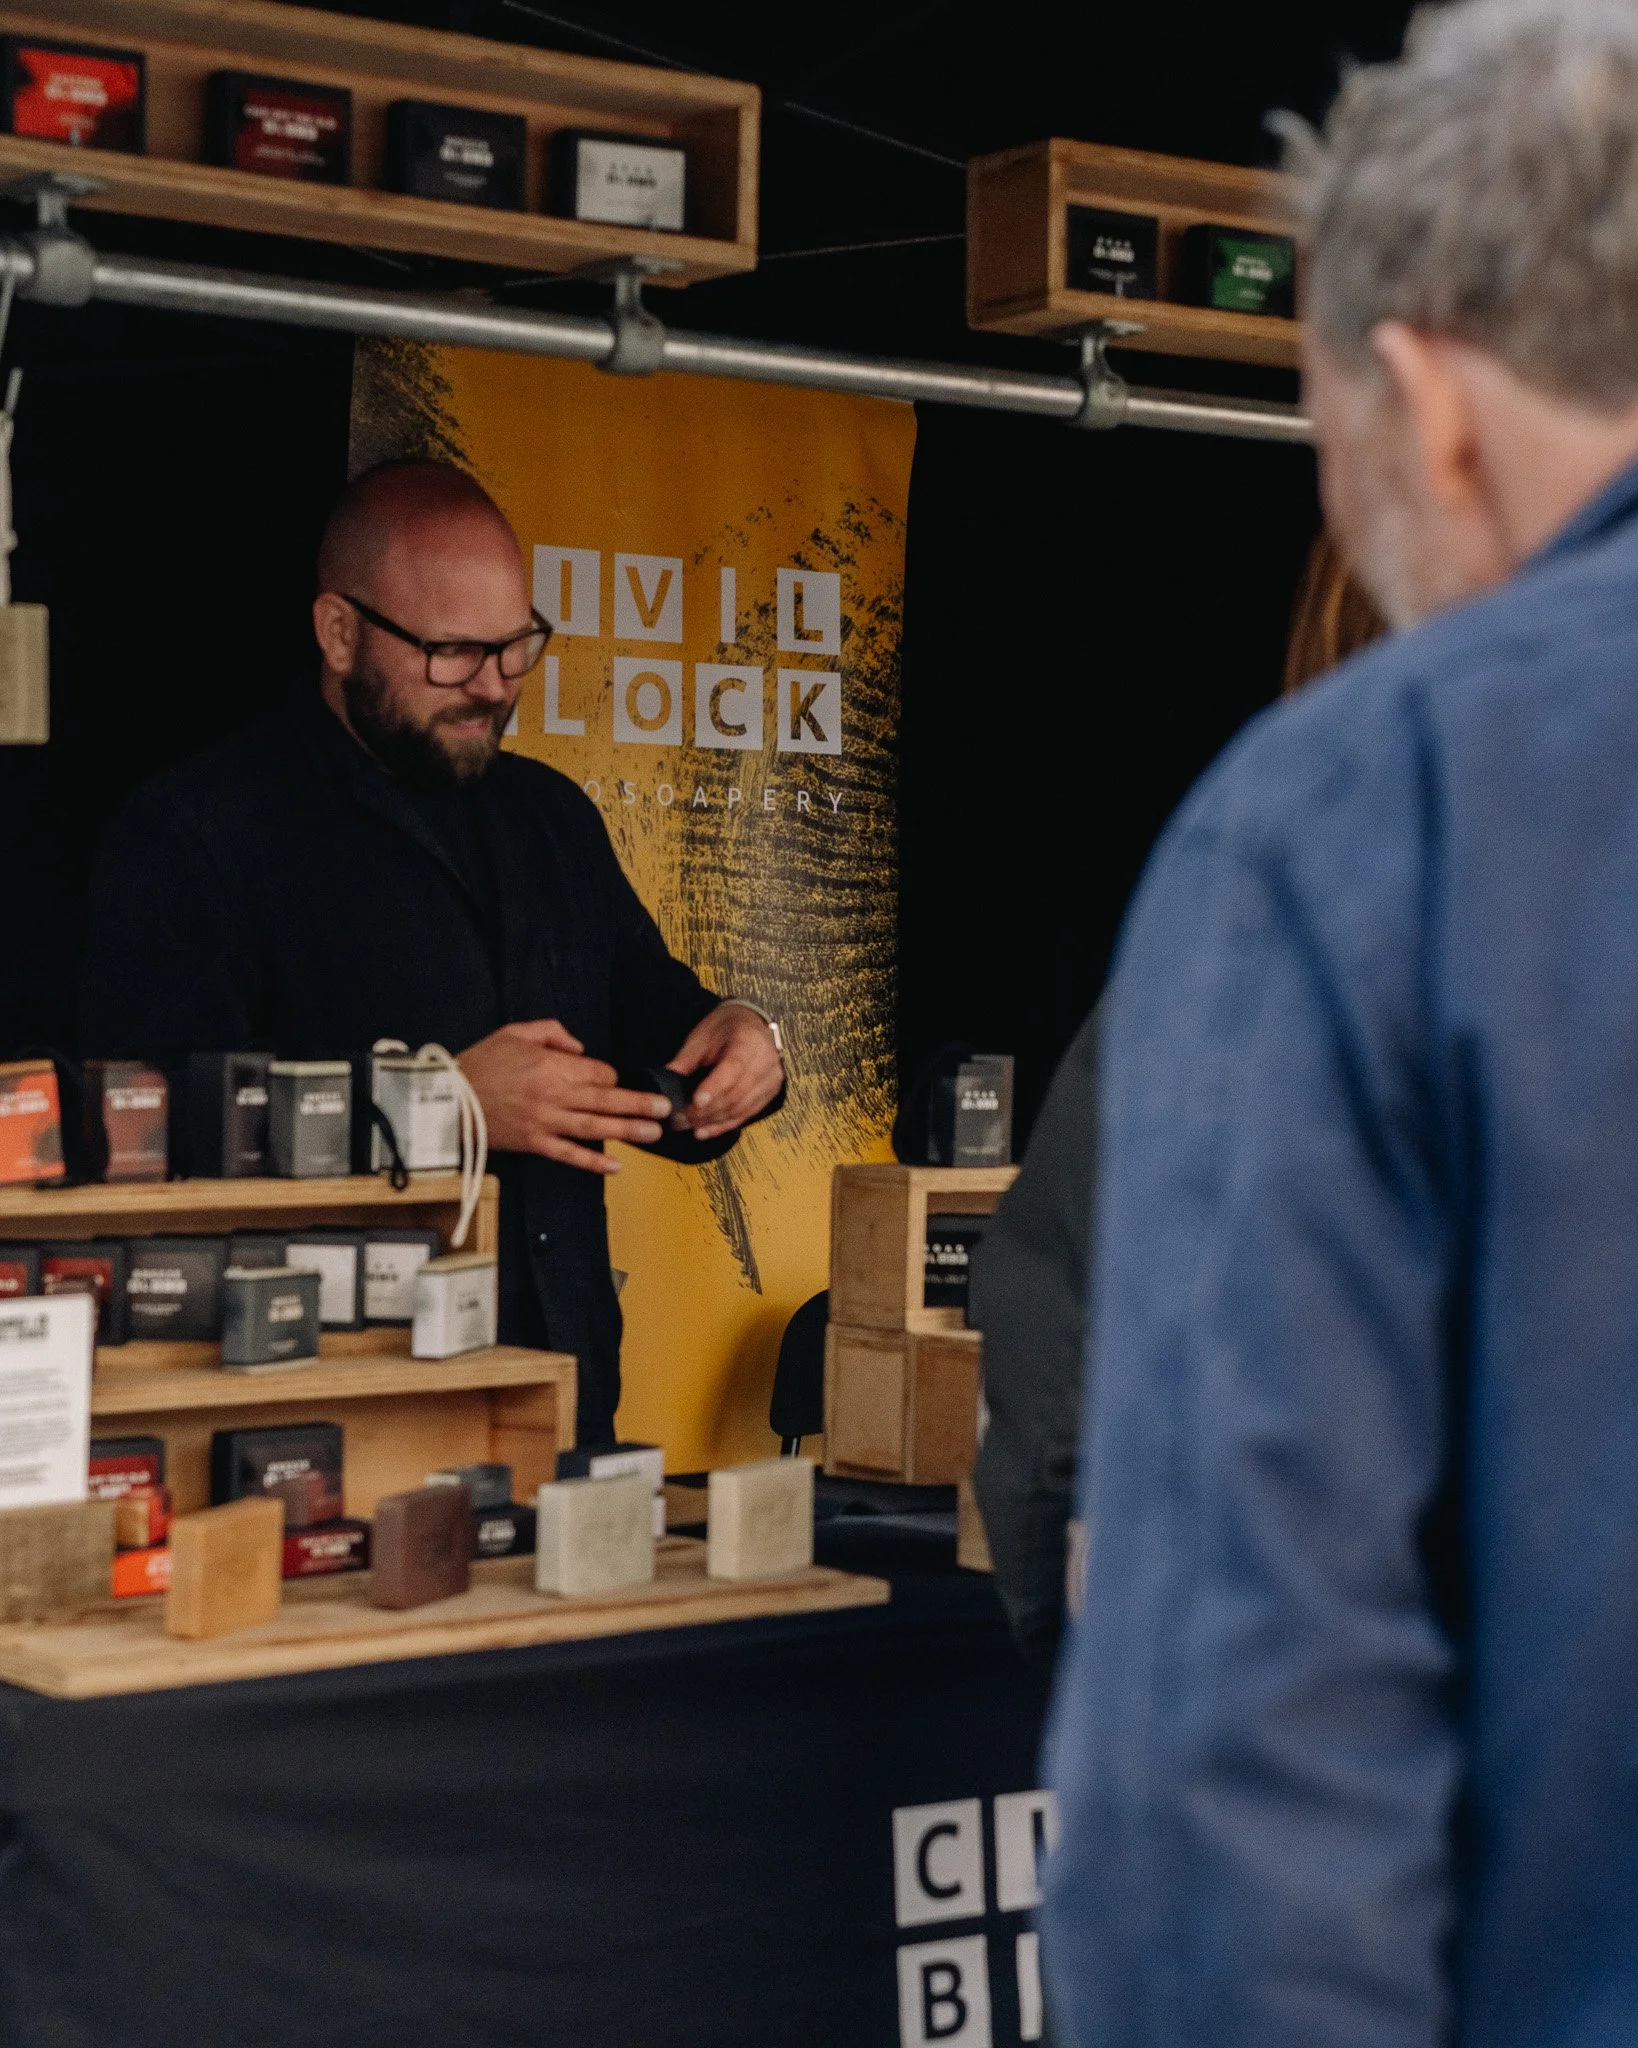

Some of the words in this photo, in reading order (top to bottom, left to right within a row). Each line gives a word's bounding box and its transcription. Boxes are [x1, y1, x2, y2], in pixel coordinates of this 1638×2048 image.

[553, 557, 828, 645] IVIL
[544, 655, 831, 745] LOCK
[584, 780, 843, 814] OSOAPERY
